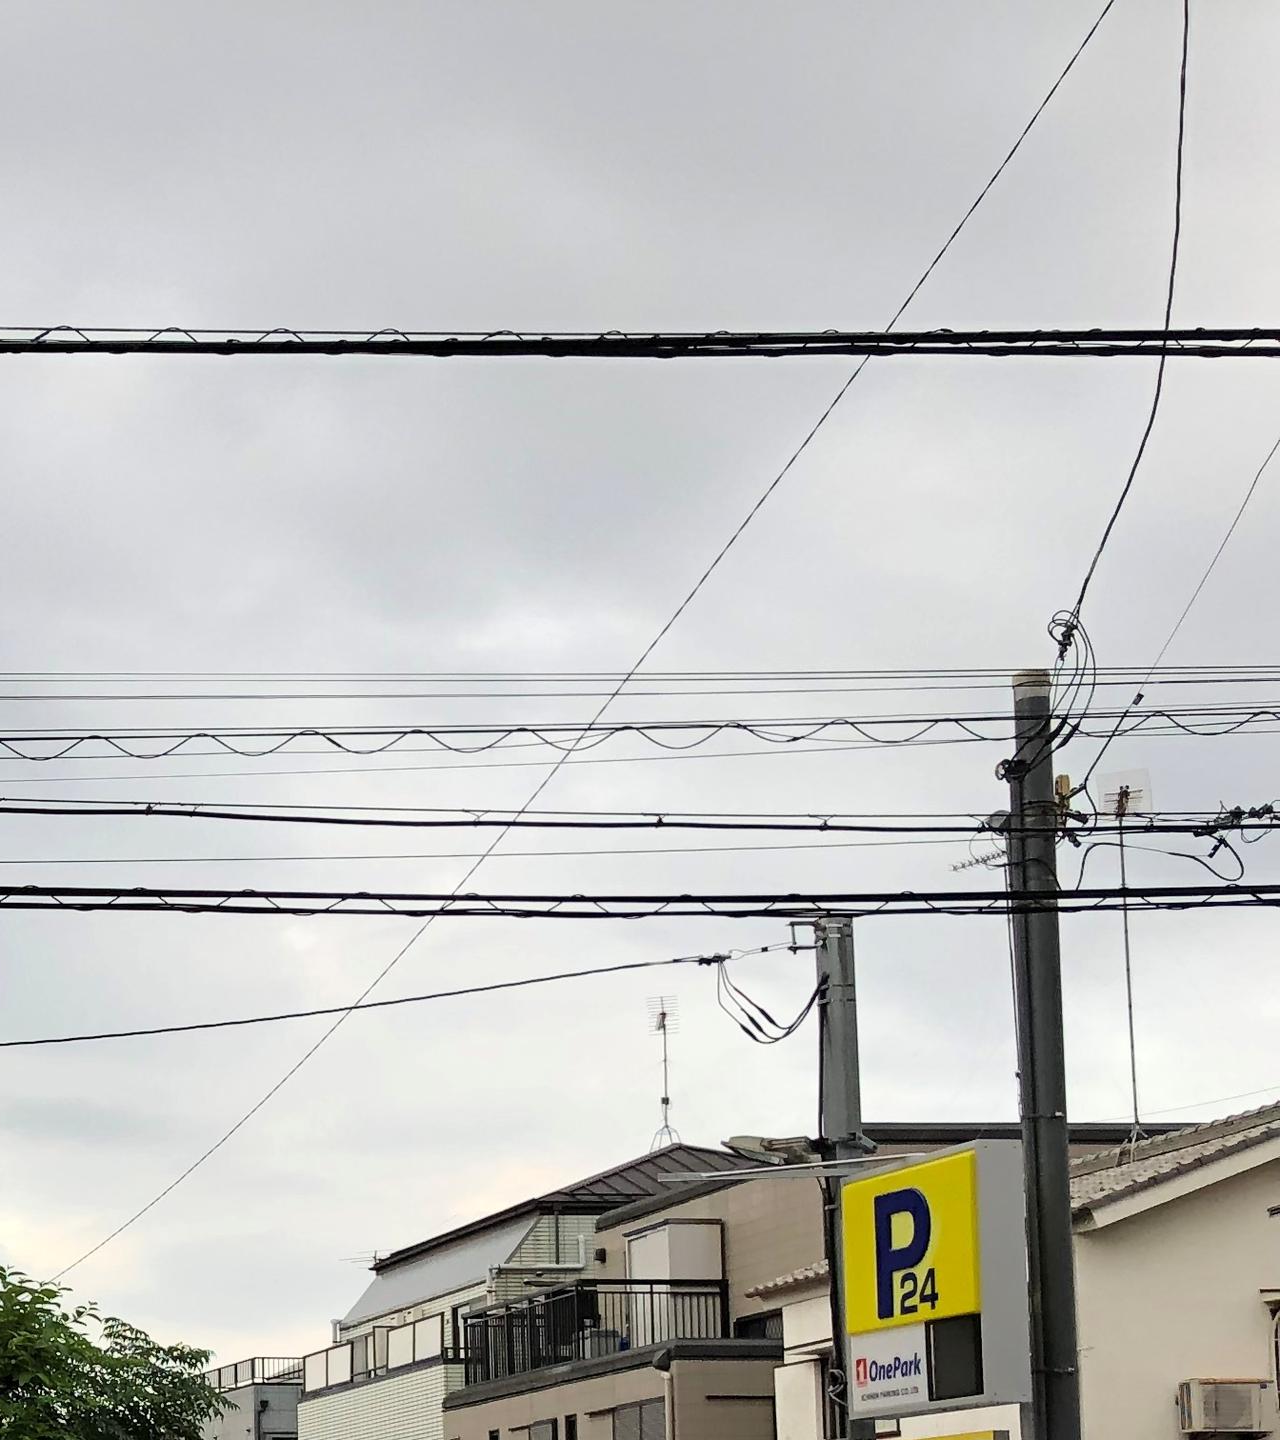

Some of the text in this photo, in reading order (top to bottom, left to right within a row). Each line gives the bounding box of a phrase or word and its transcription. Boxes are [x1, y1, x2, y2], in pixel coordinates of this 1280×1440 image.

[874, 1188, 938, 1319] P 24
[869, 1353, 921, 1381] OnePark
